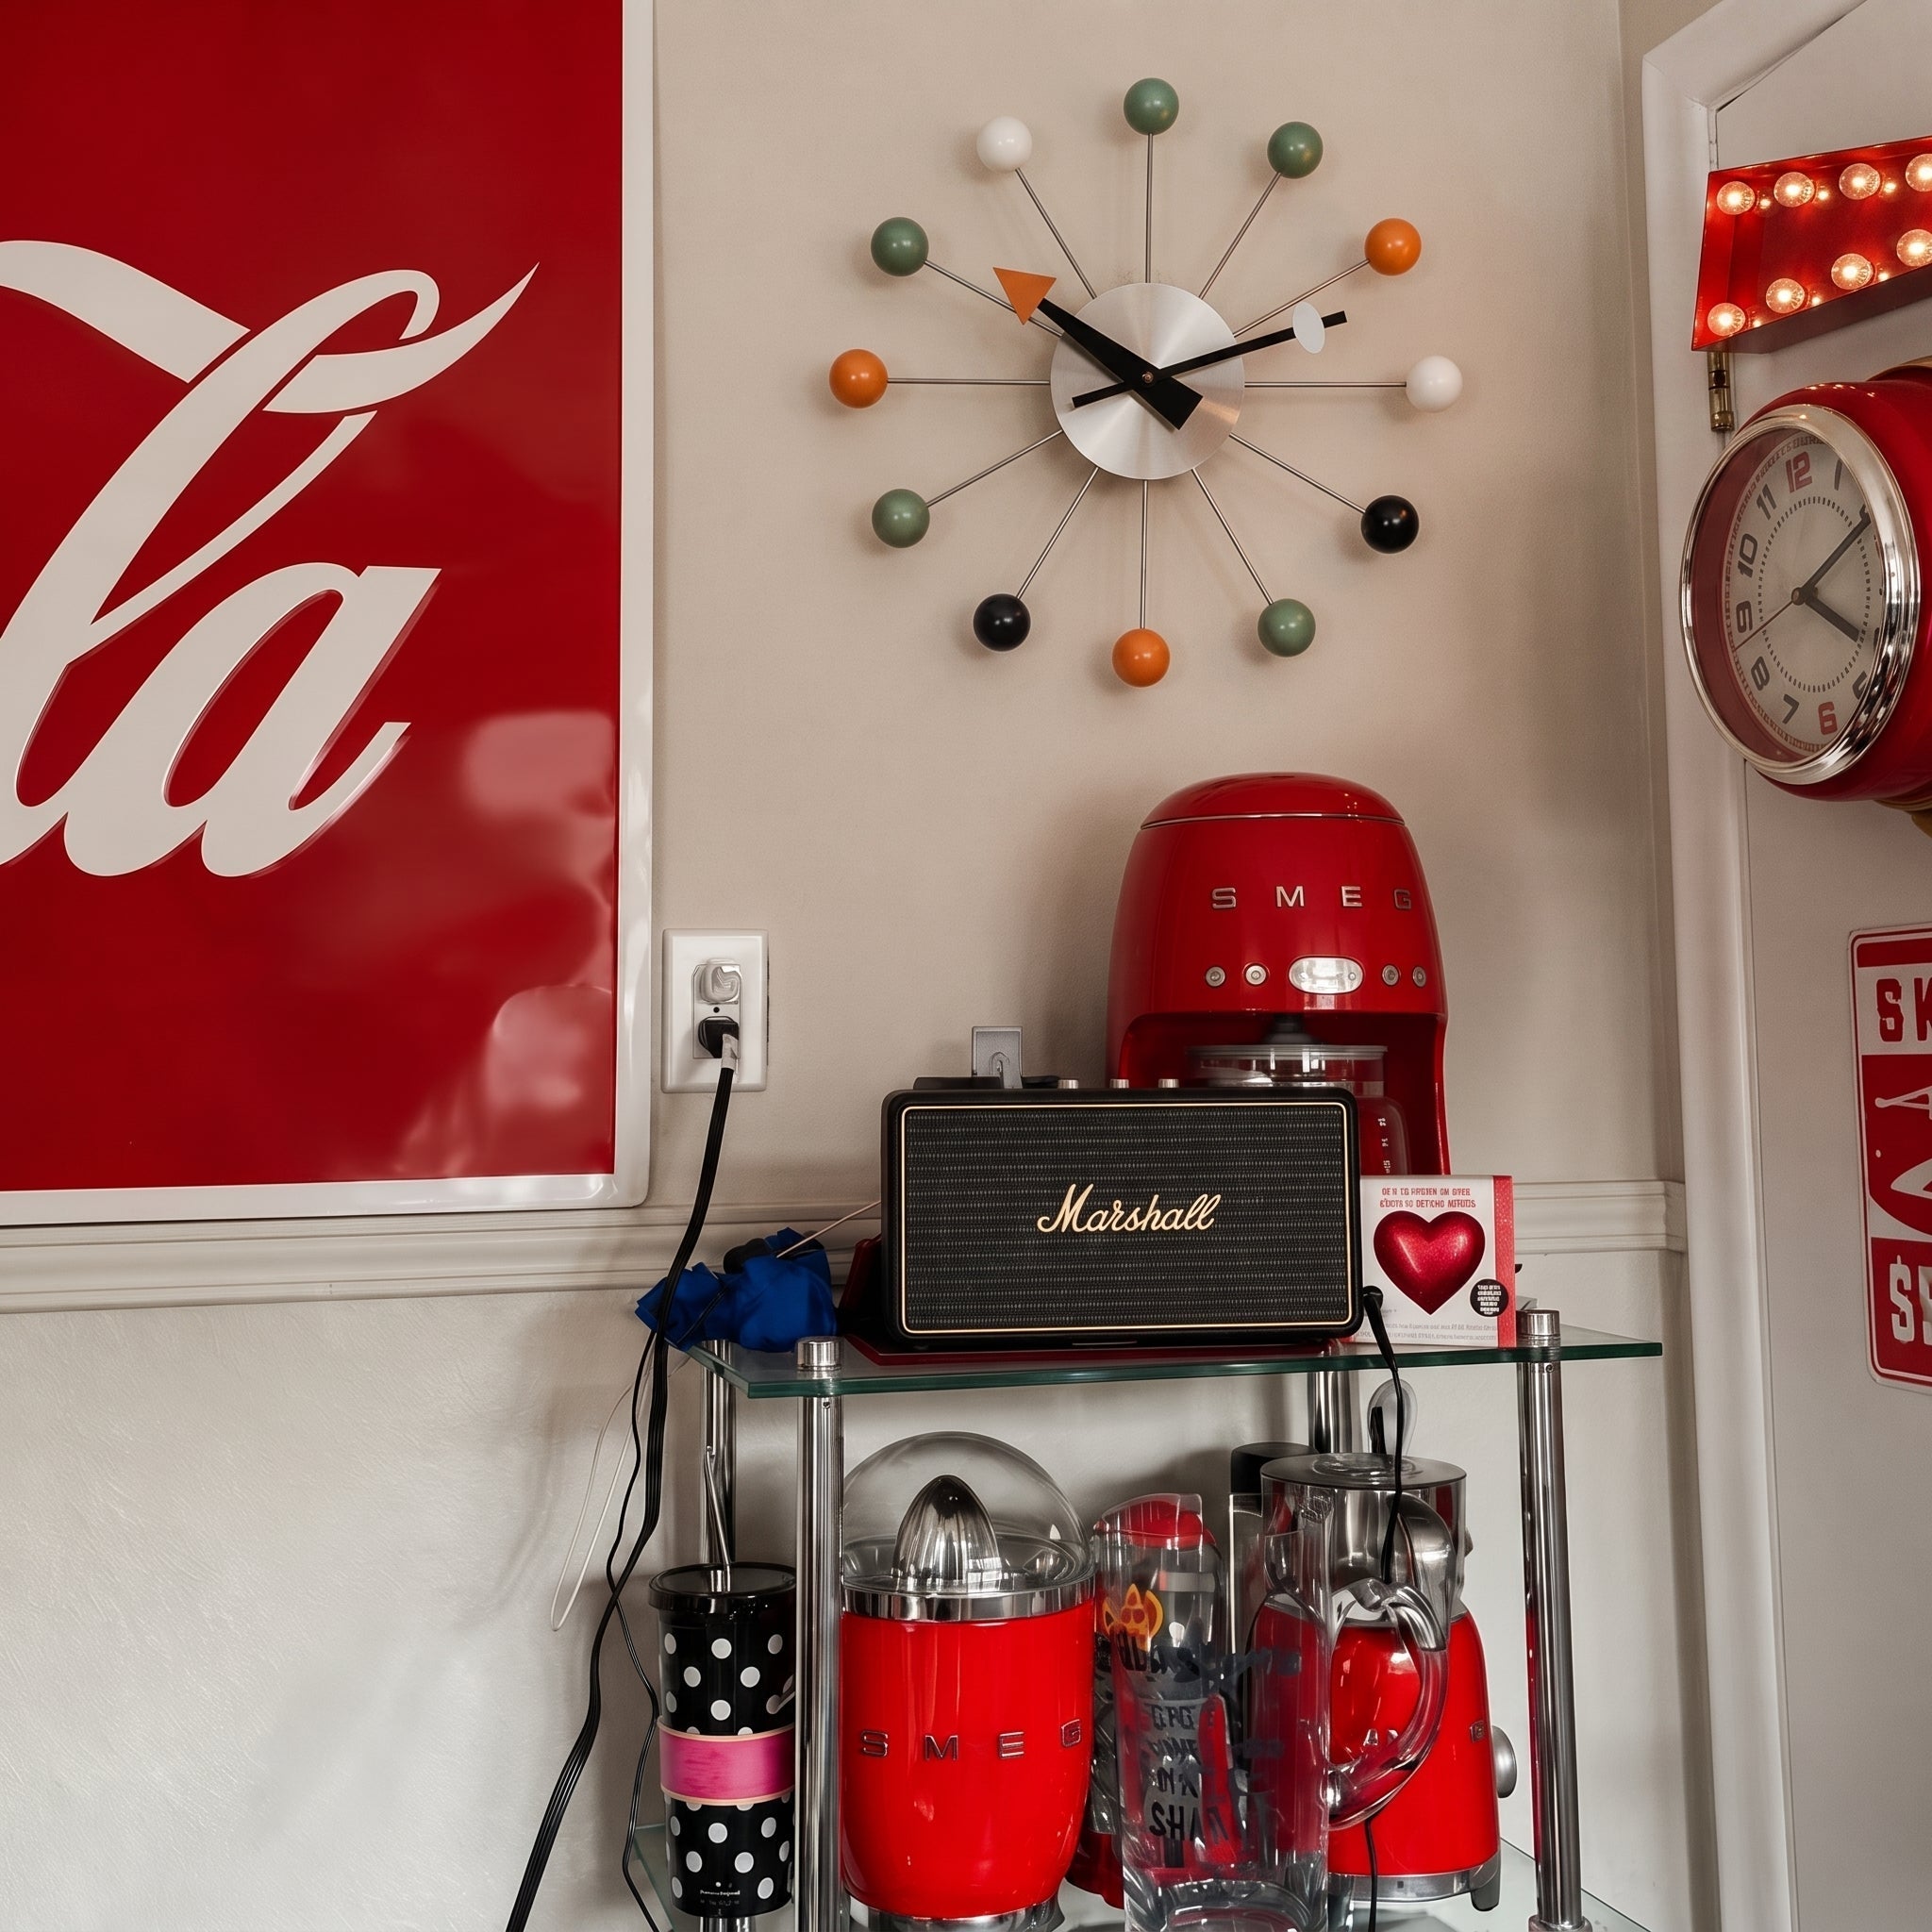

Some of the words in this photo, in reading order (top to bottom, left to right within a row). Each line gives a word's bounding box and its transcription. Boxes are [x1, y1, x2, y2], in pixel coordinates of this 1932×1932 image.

[1785, 451, 1813, 493] 12
[1757, 484, 1776, 521] 11
[1737, 533, 1758, 578] 10
[1736, 600, 1753, 633] 9
[1751, 656, 1771, 691] 8
[1782, 694, 1799, 724] 7
[1818, 701, 1838, 736] 6
[1211, 885, 1412, 910] SMEG
[1038, 1183, 1222, 1233] Marshall
[859, 1718, 1082, 1761] SMEG
